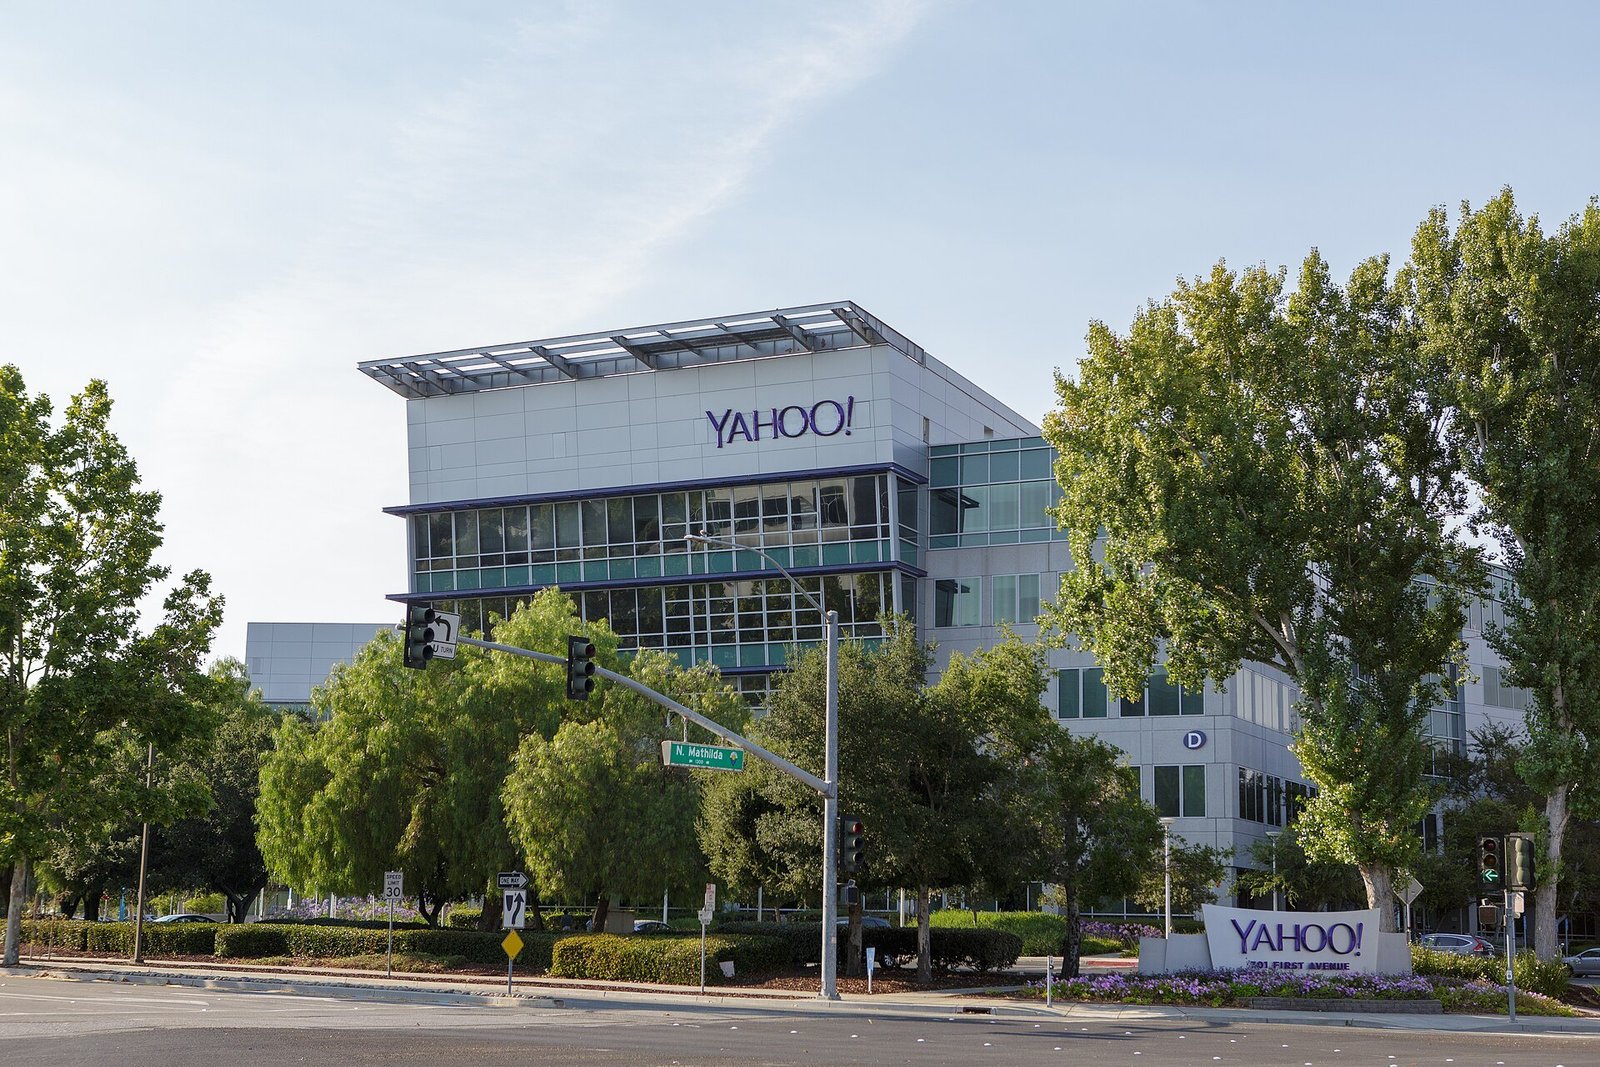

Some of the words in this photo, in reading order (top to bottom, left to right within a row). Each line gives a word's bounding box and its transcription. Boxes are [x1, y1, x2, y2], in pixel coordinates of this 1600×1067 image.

[705, 395, 854, 448] YAHOO!
[433, 644, 439, 652] U
[1188, 732, 1202, 748] D
[676, 745, 685, 756] N.
[688, 746, 723, 760] Mathilda
[386, 887, 401, 898] 30
[1230, 919, 1364, 957] YAHOO!
[1272, 961, 1304, 970] FIRST
[1307, 962, 1350, 970] AVENUE
